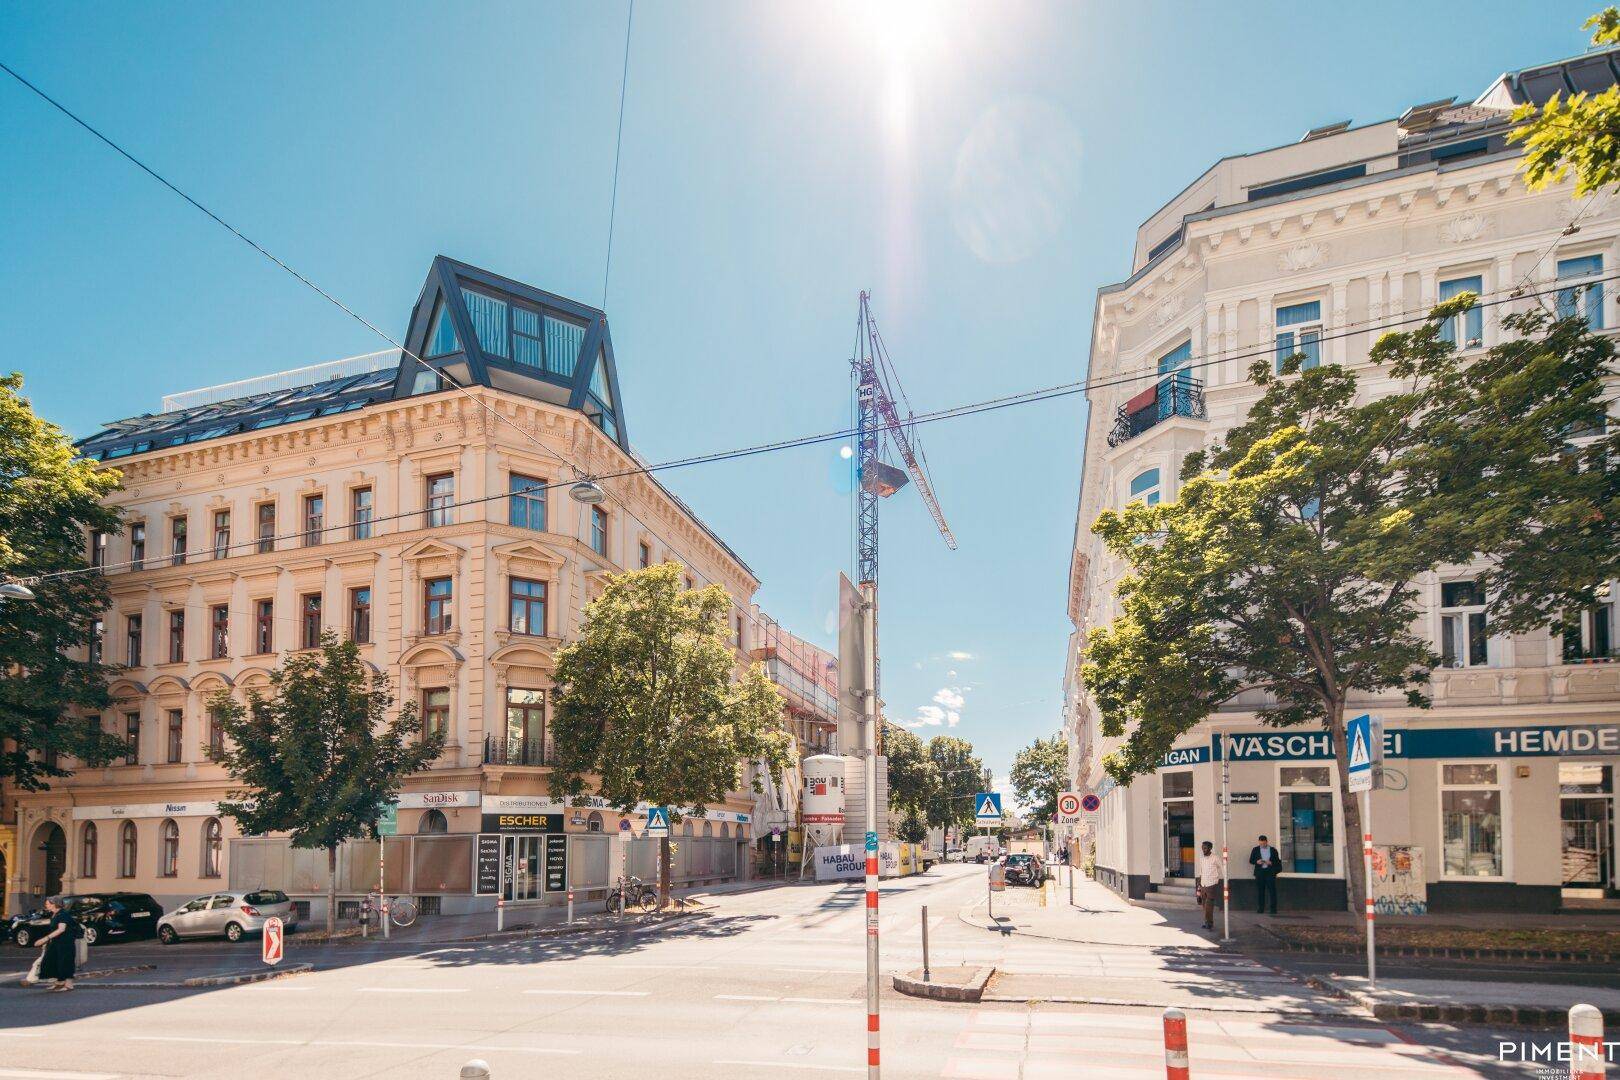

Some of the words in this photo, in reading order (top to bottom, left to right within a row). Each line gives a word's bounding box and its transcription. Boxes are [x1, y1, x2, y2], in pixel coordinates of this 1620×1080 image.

[860, 388, 873, 397] HG
[1219, 733, 1402, 757] WÄSCHEI
[1494, 728, 1619, 752] HEMDE
[1164, 749, 1200, 765] IGAN
[423, 793, 458, 803] SanDisk
[165, 804, 187, 812] Nissin
[1064, 800, 1075, 810] 30
[499, 815, 547, 826] ESCHER
[1061, 816, 1079, 824] Zone
[823, 854, 855, 864] HABAU
[505, 855, 513, 884] SIGMA
